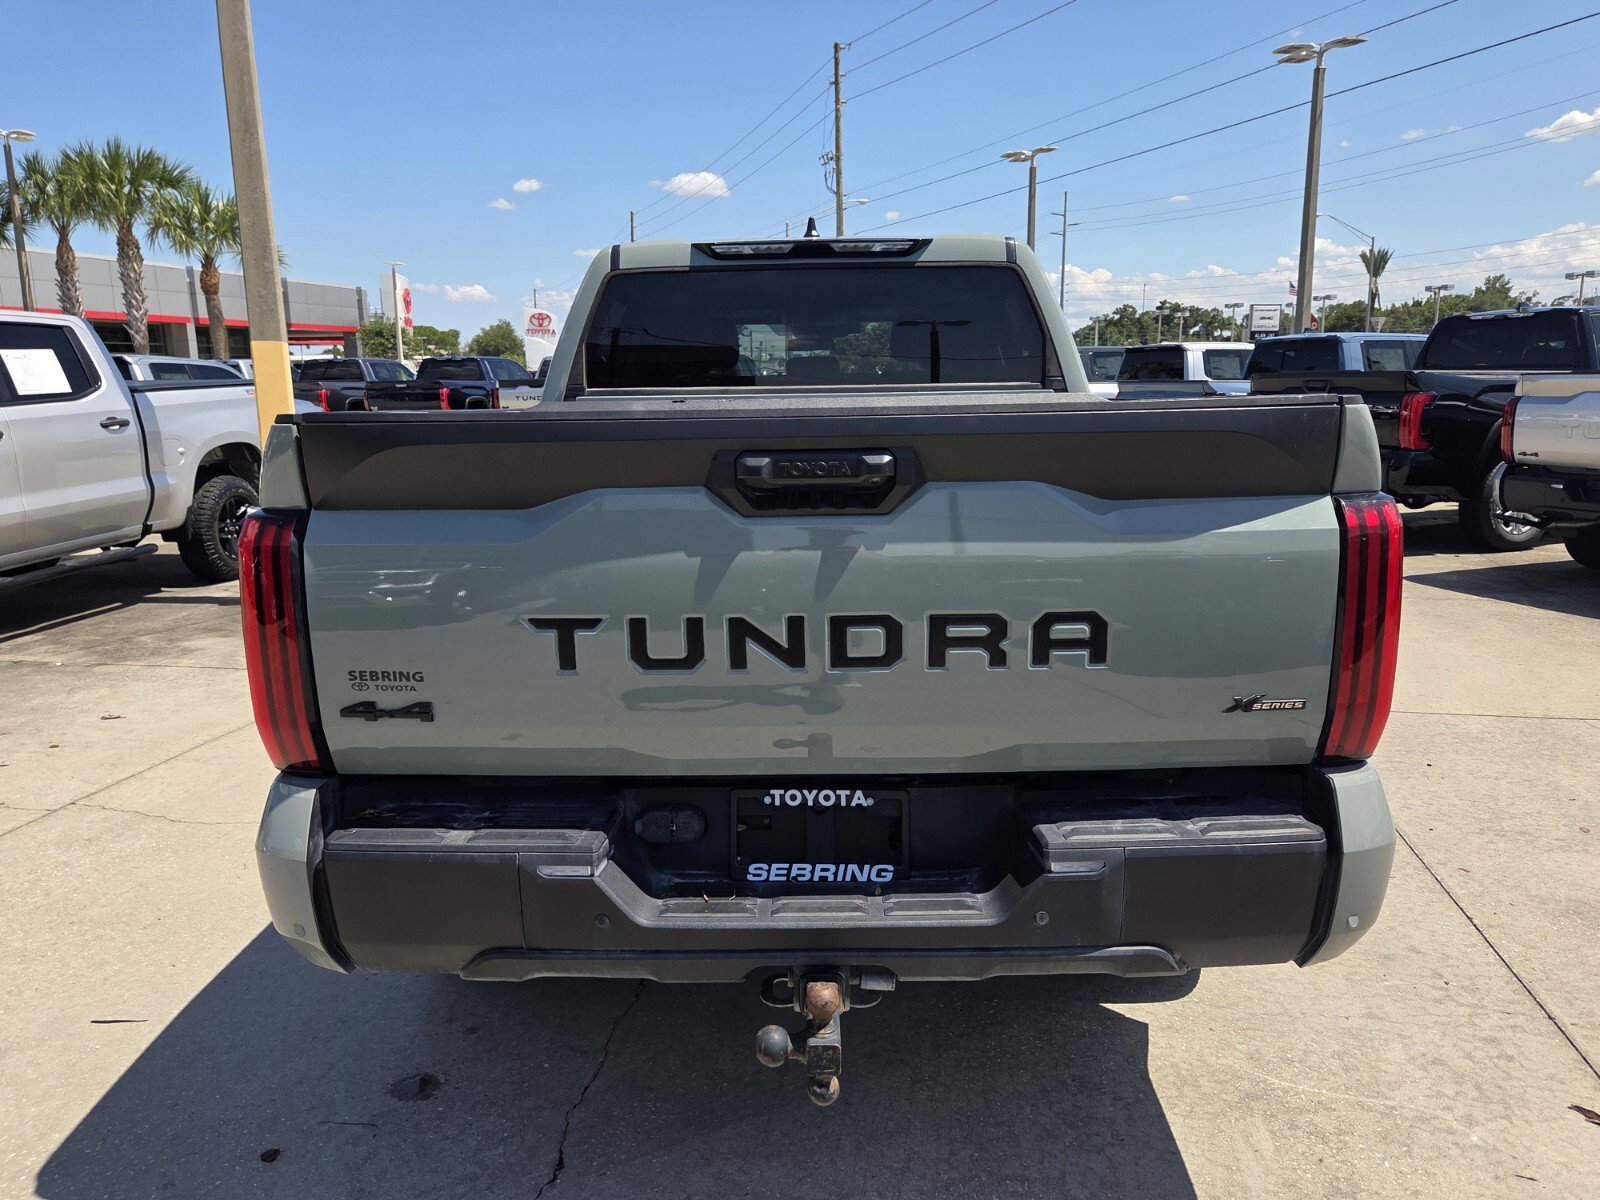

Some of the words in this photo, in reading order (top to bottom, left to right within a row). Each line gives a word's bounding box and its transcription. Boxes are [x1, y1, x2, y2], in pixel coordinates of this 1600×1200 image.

[779, 461, 851, 477] TOYOTA
[519, 610, 1110, 676] TUNDRA
[347, 670, 425, 683] SEBRING
[374, 684, 418, 692] TOYOTA
[1251, 701, 1304, 710] SERIES
[769, 789, 868, 807] TOYOTA
[746, 863, 895, 882] SEBRING
